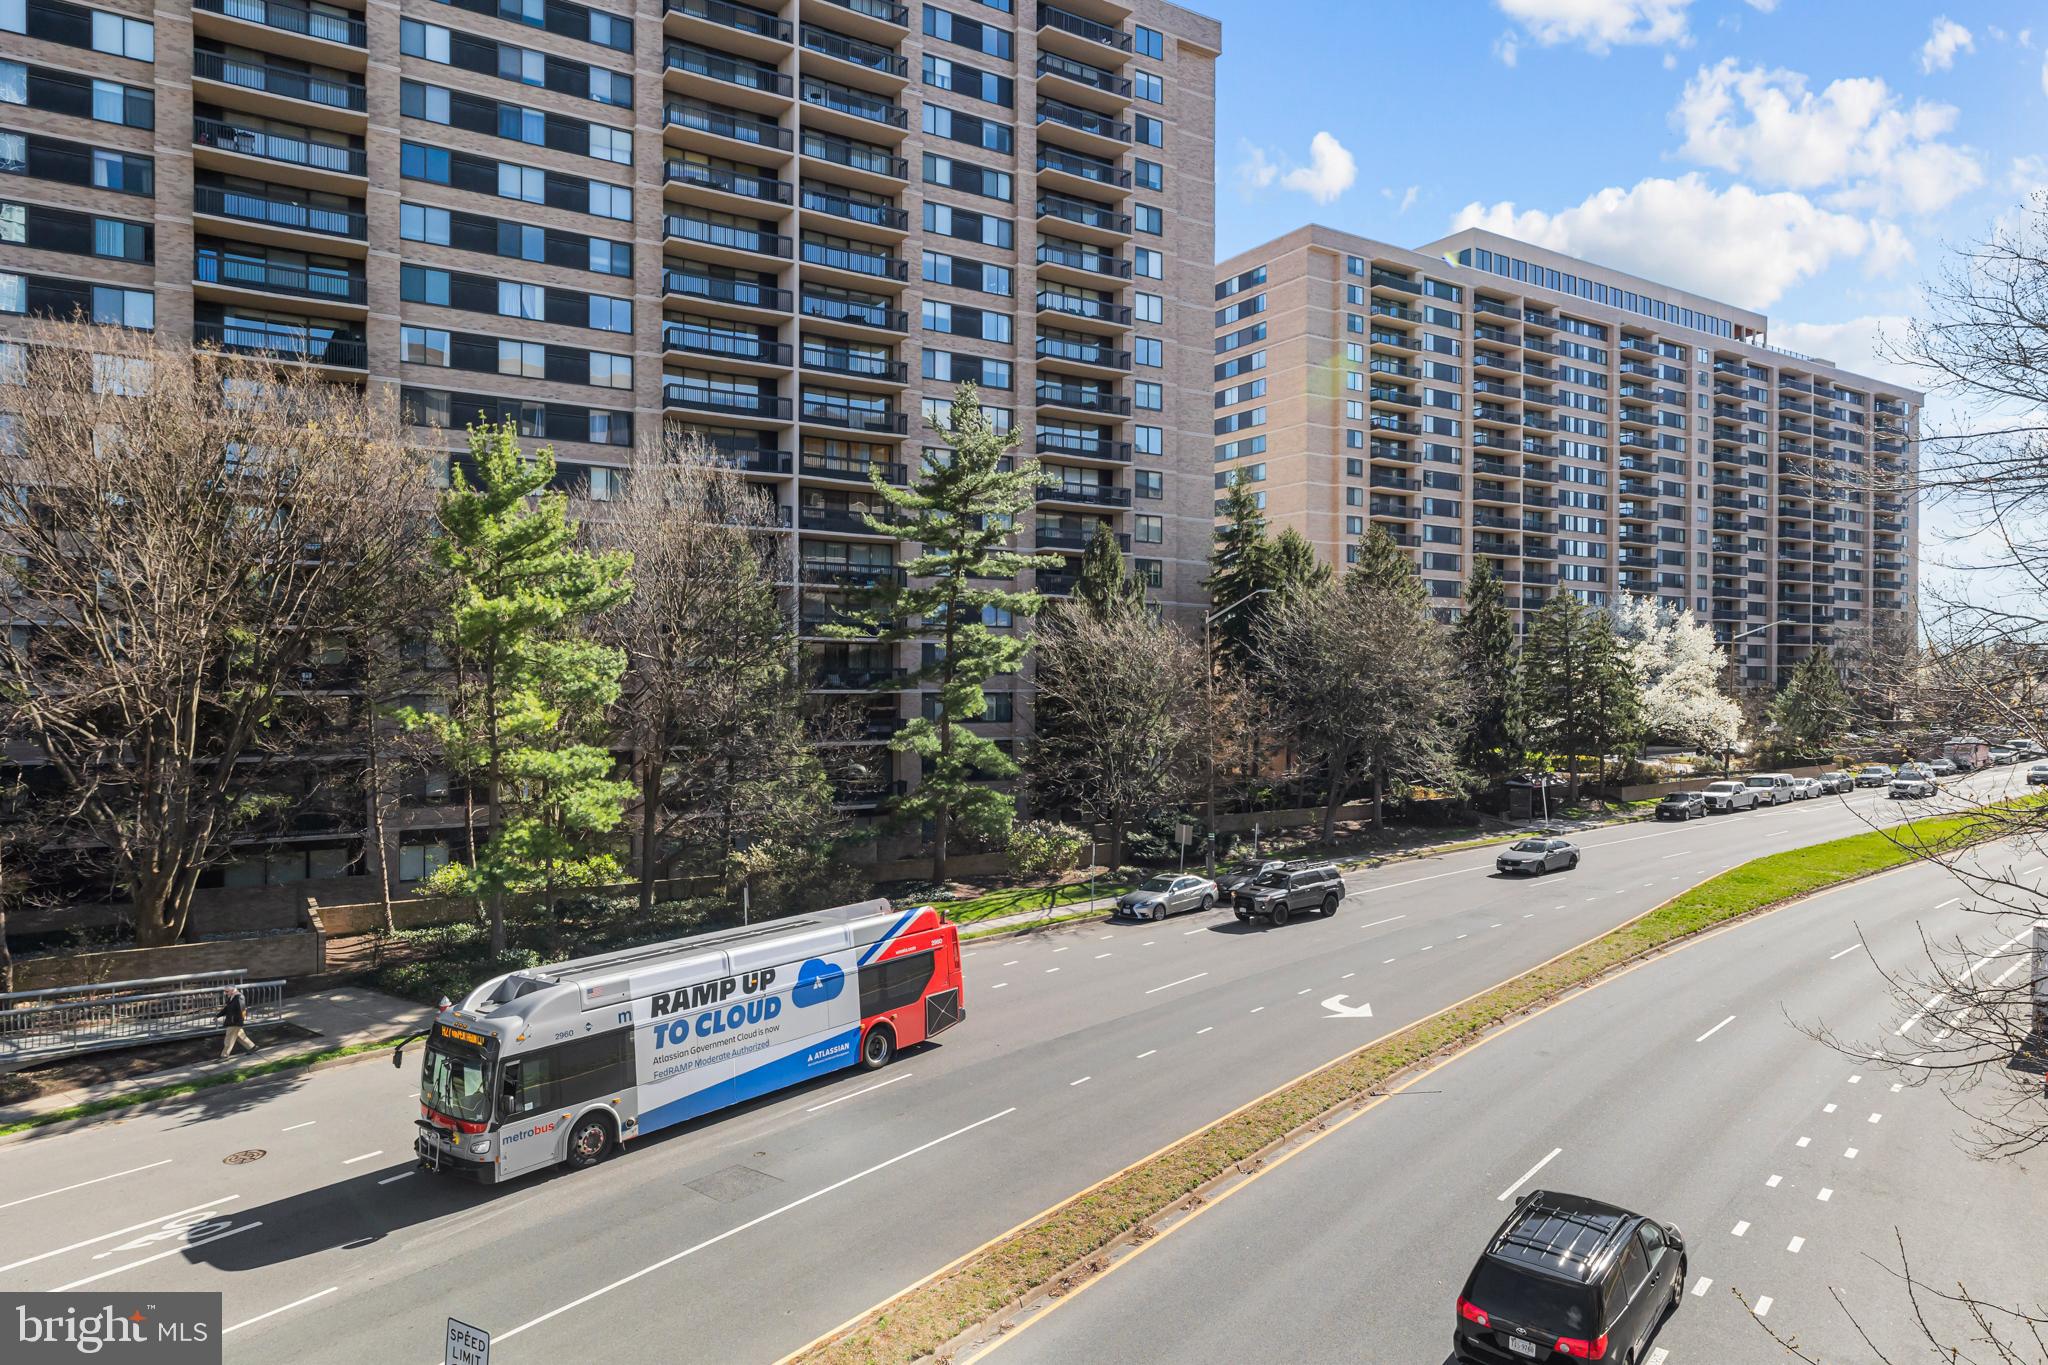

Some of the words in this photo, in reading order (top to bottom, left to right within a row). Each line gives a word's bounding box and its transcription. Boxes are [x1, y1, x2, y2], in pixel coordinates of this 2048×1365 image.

[651, 977, 736, 1018] RAMP
[743, 969, 776, 995] UP
[555, 1029, 574, 1040] 2960
[653, 1019, 690, 1050] TO
[695, 996, 782, 1038] CLOUD
[653, 1050, 690, 1065] Atlassian
[690, 1036, 736, 1055] Government
[737, 1028, 757, 1042] Cloud
[758, 1028, 764, 1037] is
[765, 1024, 780, 1036] now
[814, 1042, 850, 1060] ATLASSIAN
[653, 1061, 693, 1079] FedRAMP
[694, 1053, 731, 1068] Moderate
[731, 1039, 770, 1060] Authorized
[502, 1122, 555, 1146] metrobus
[450, 1328, 486, 1352] SPEED
[452, 1346, 481, 1365] LIMIT
